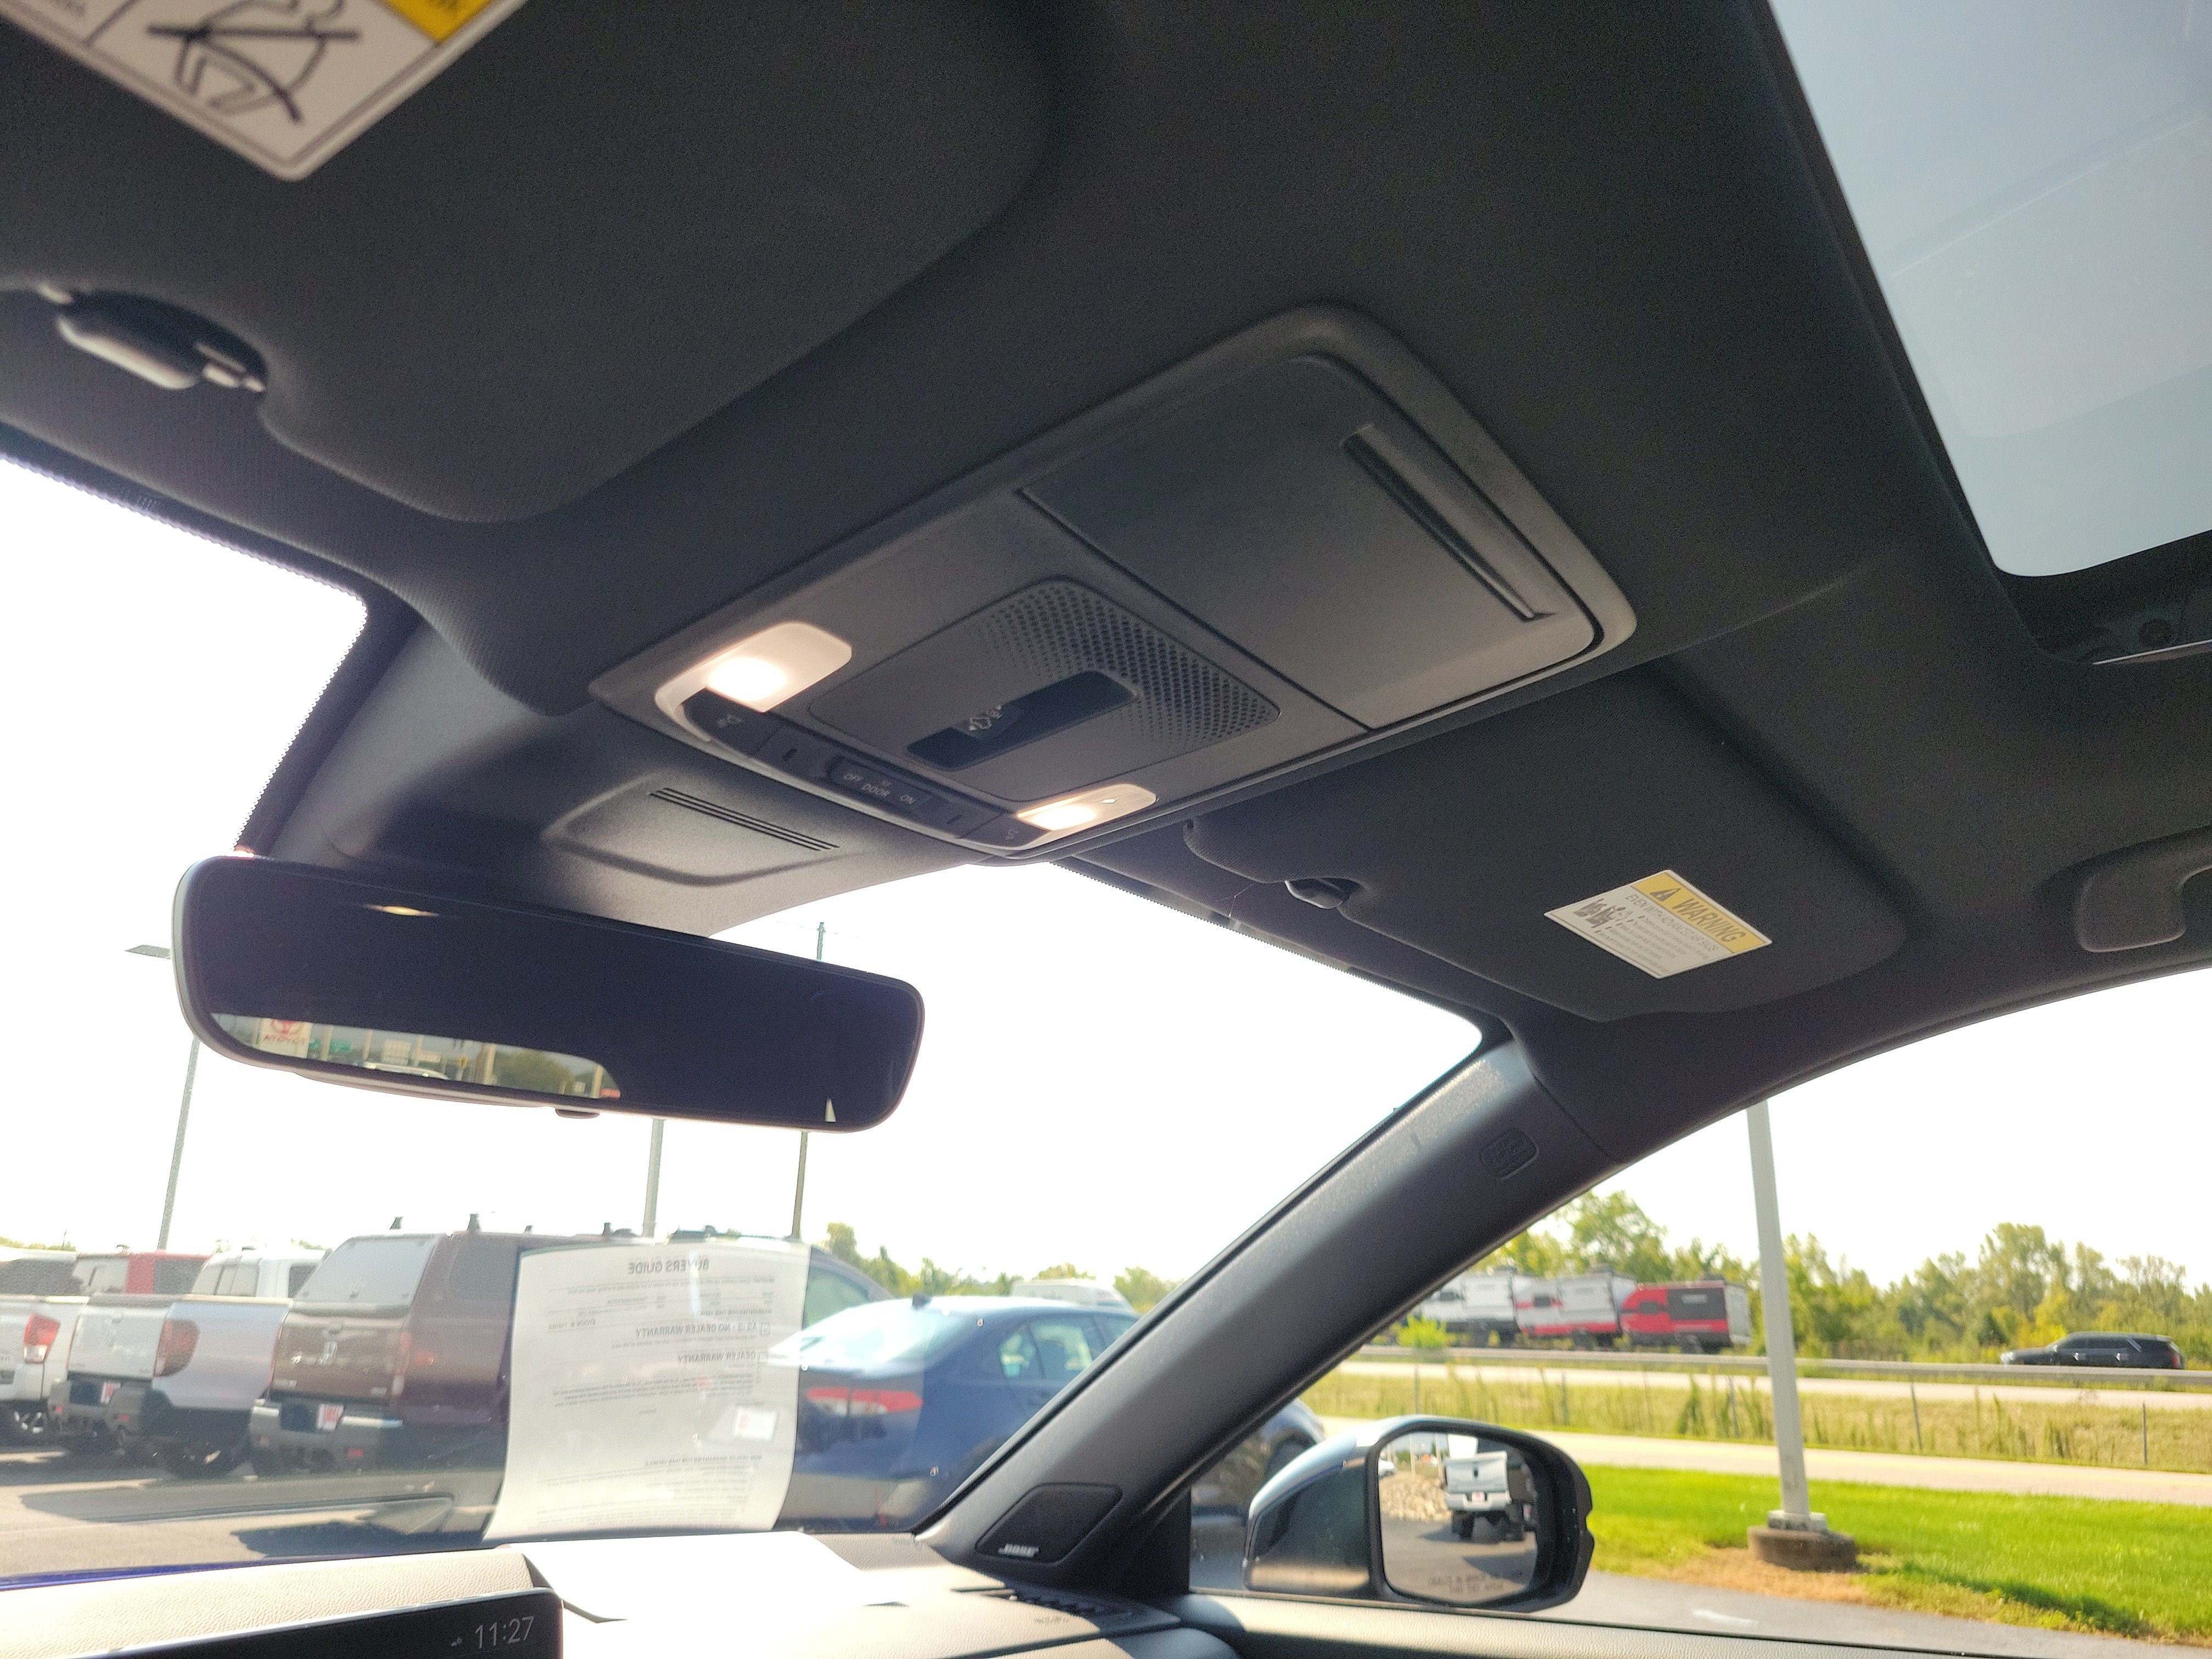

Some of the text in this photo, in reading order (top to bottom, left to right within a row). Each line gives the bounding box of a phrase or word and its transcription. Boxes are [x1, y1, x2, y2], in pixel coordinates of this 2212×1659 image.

[862, 783, 891, 798] DOOR
[900, 794, 917, 805] ON
[1672, 897, 1747, 943] WARNING
[474, 1615, 535, 1649] 11:27
